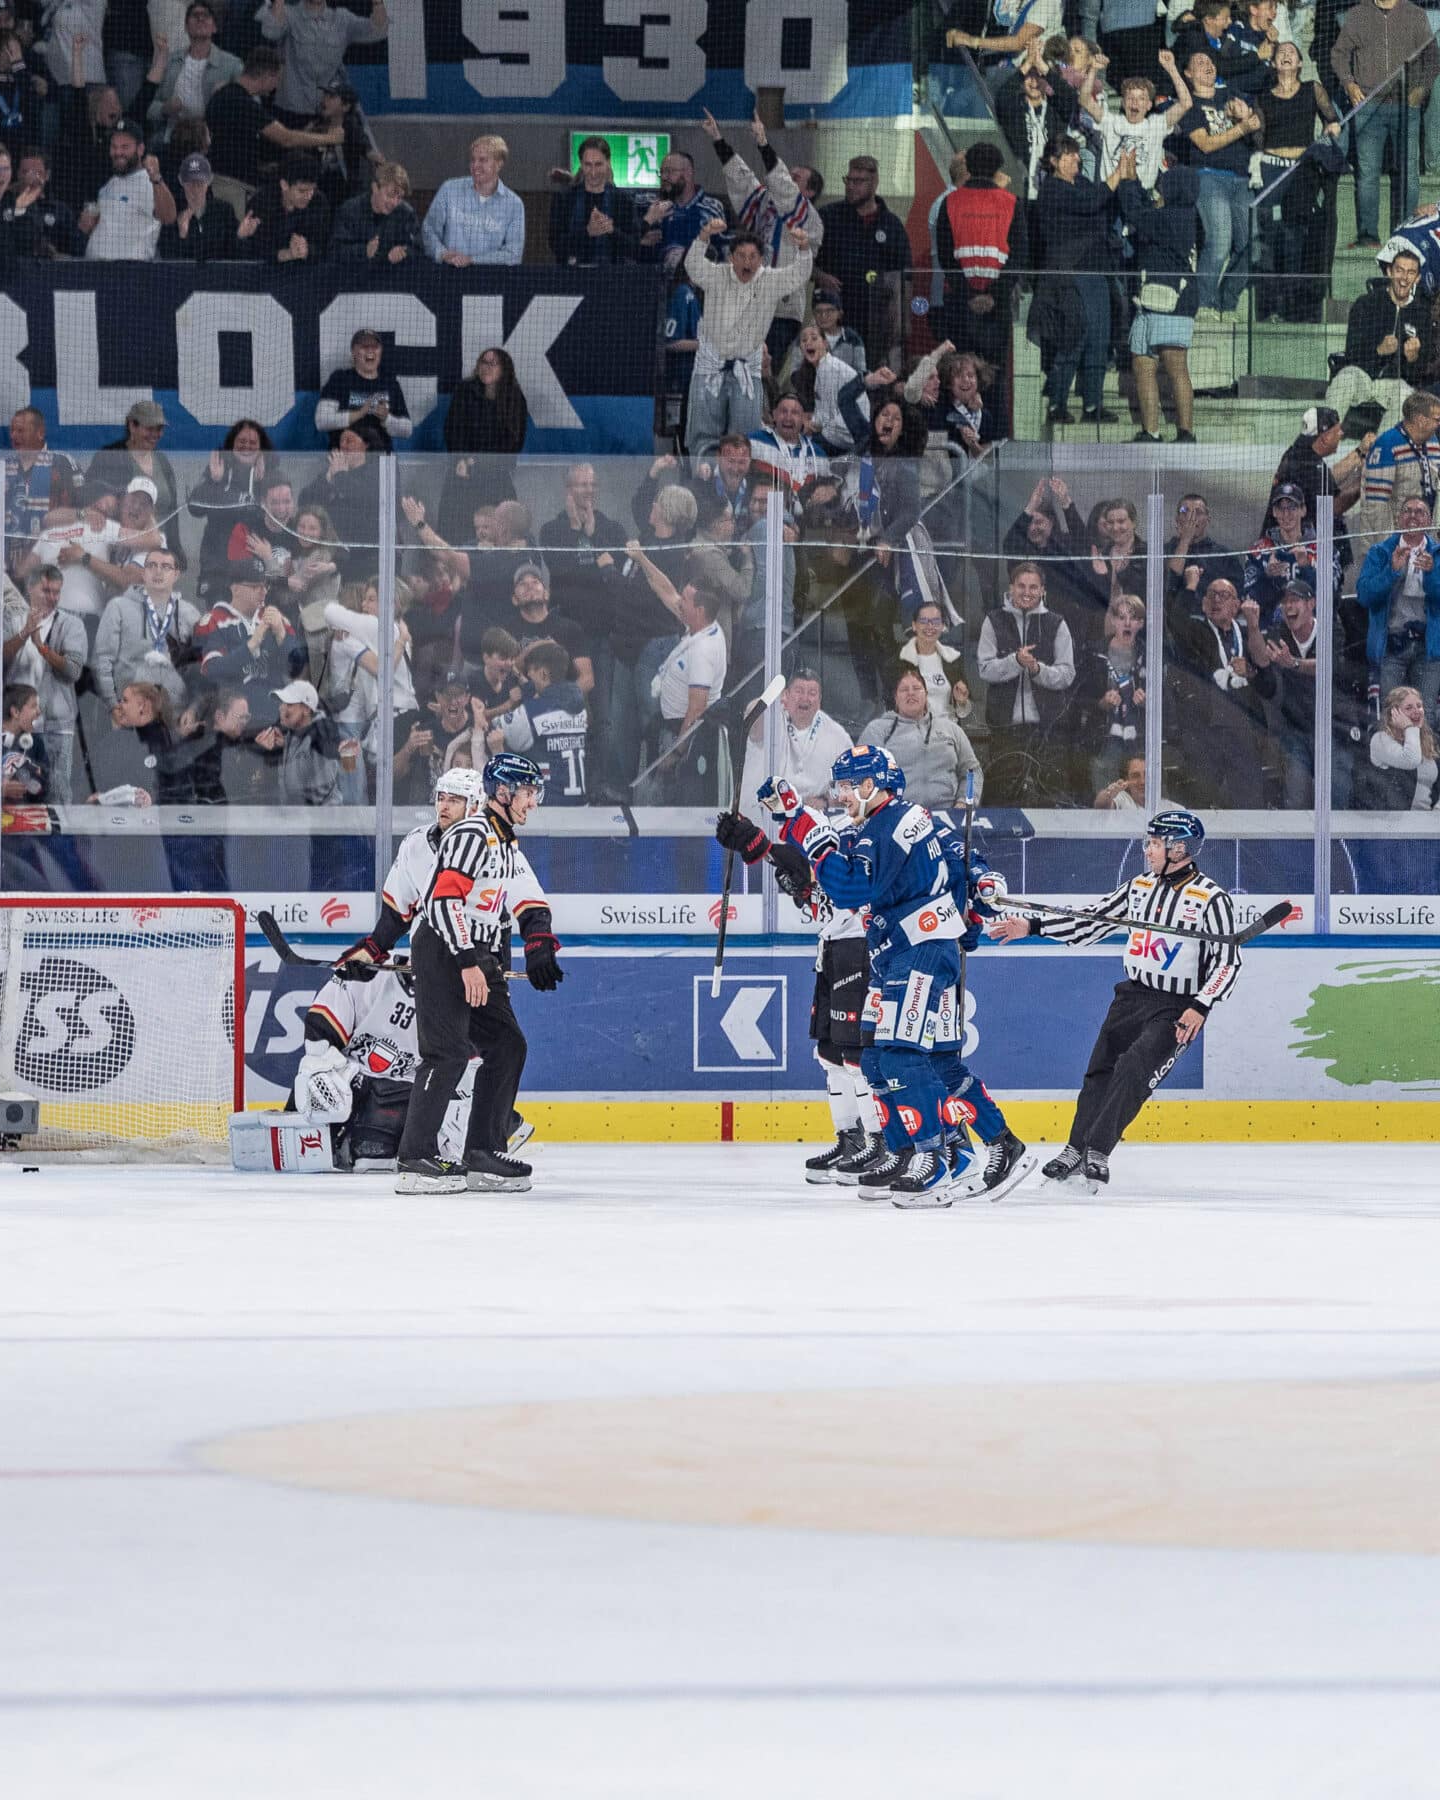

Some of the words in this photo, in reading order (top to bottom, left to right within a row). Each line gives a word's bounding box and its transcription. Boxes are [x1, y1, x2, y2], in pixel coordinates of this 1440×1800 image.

[388, 0, 848, 101] 1938
[601, 904, 696, 925] SwissLife
[1338, 904, 1435, 925] SwissLife
[1128, 928, 1183, 971] sky
[389, 1001, 416, 1030] 33
